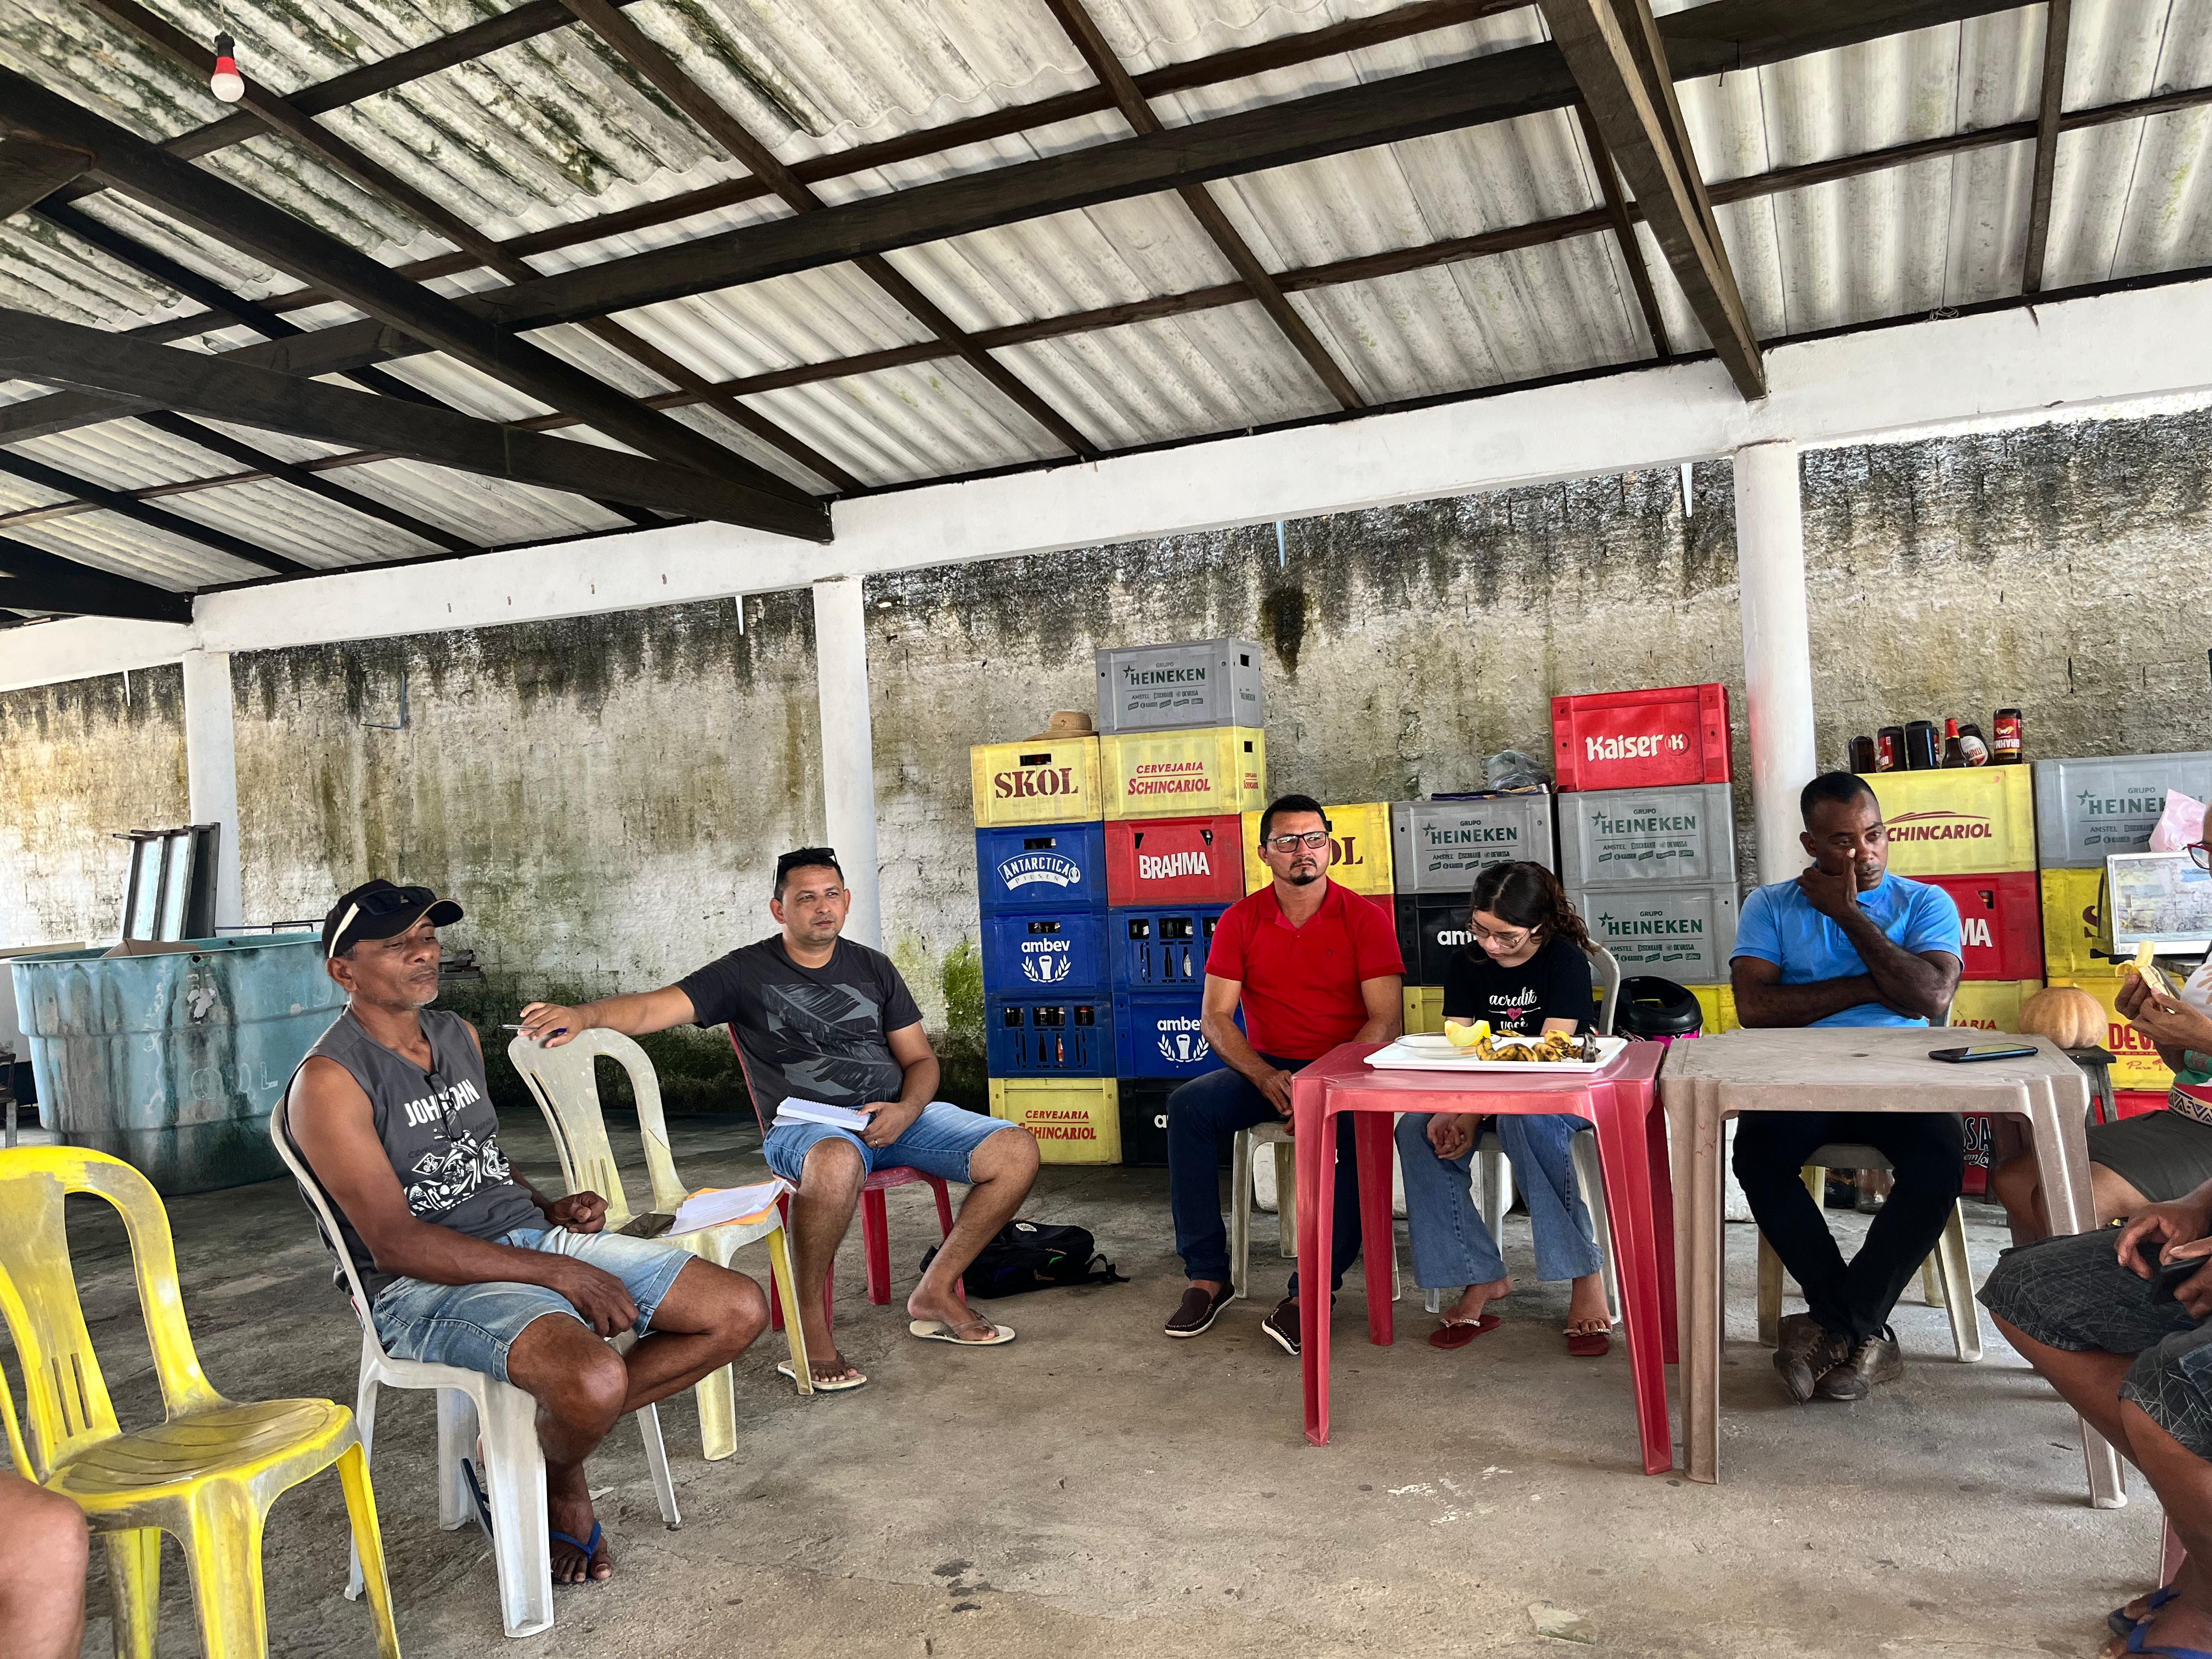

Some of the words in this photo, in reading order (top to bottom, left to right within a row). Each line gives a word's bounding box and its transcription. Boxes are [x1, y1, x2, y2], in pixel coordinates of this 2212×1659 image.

[1131, 668, 1205, 685] HEINEKEN
[1585, 734, 1664, 762] Kaiser
[1136, 761, 1203, 774] CERVEJARIA
[994, 768, 1079, 799] SKOL
[1128, 778, 1211, 795] SCHINCARIOL
[2089, 797, 2166, 814] HEINE
[1601, 816, 1696, 834] HEINEKEN
[1887, 823, 1992, 842] CHINCARIOL
[1431, 827, 1517, 844] HEINEKEN
[1003, 857, 1070, 880] ANTARCTICA
[1139, 851, 1210, 879] BRAHMA
[1015, 873, 1059, 884] PILSEN
[1608, 919, 1702, 935] HEINEKEN
[1021, 938, 1070, 953] ambev
[1025, 1110, 1089, 1119] CERVEJARIA
